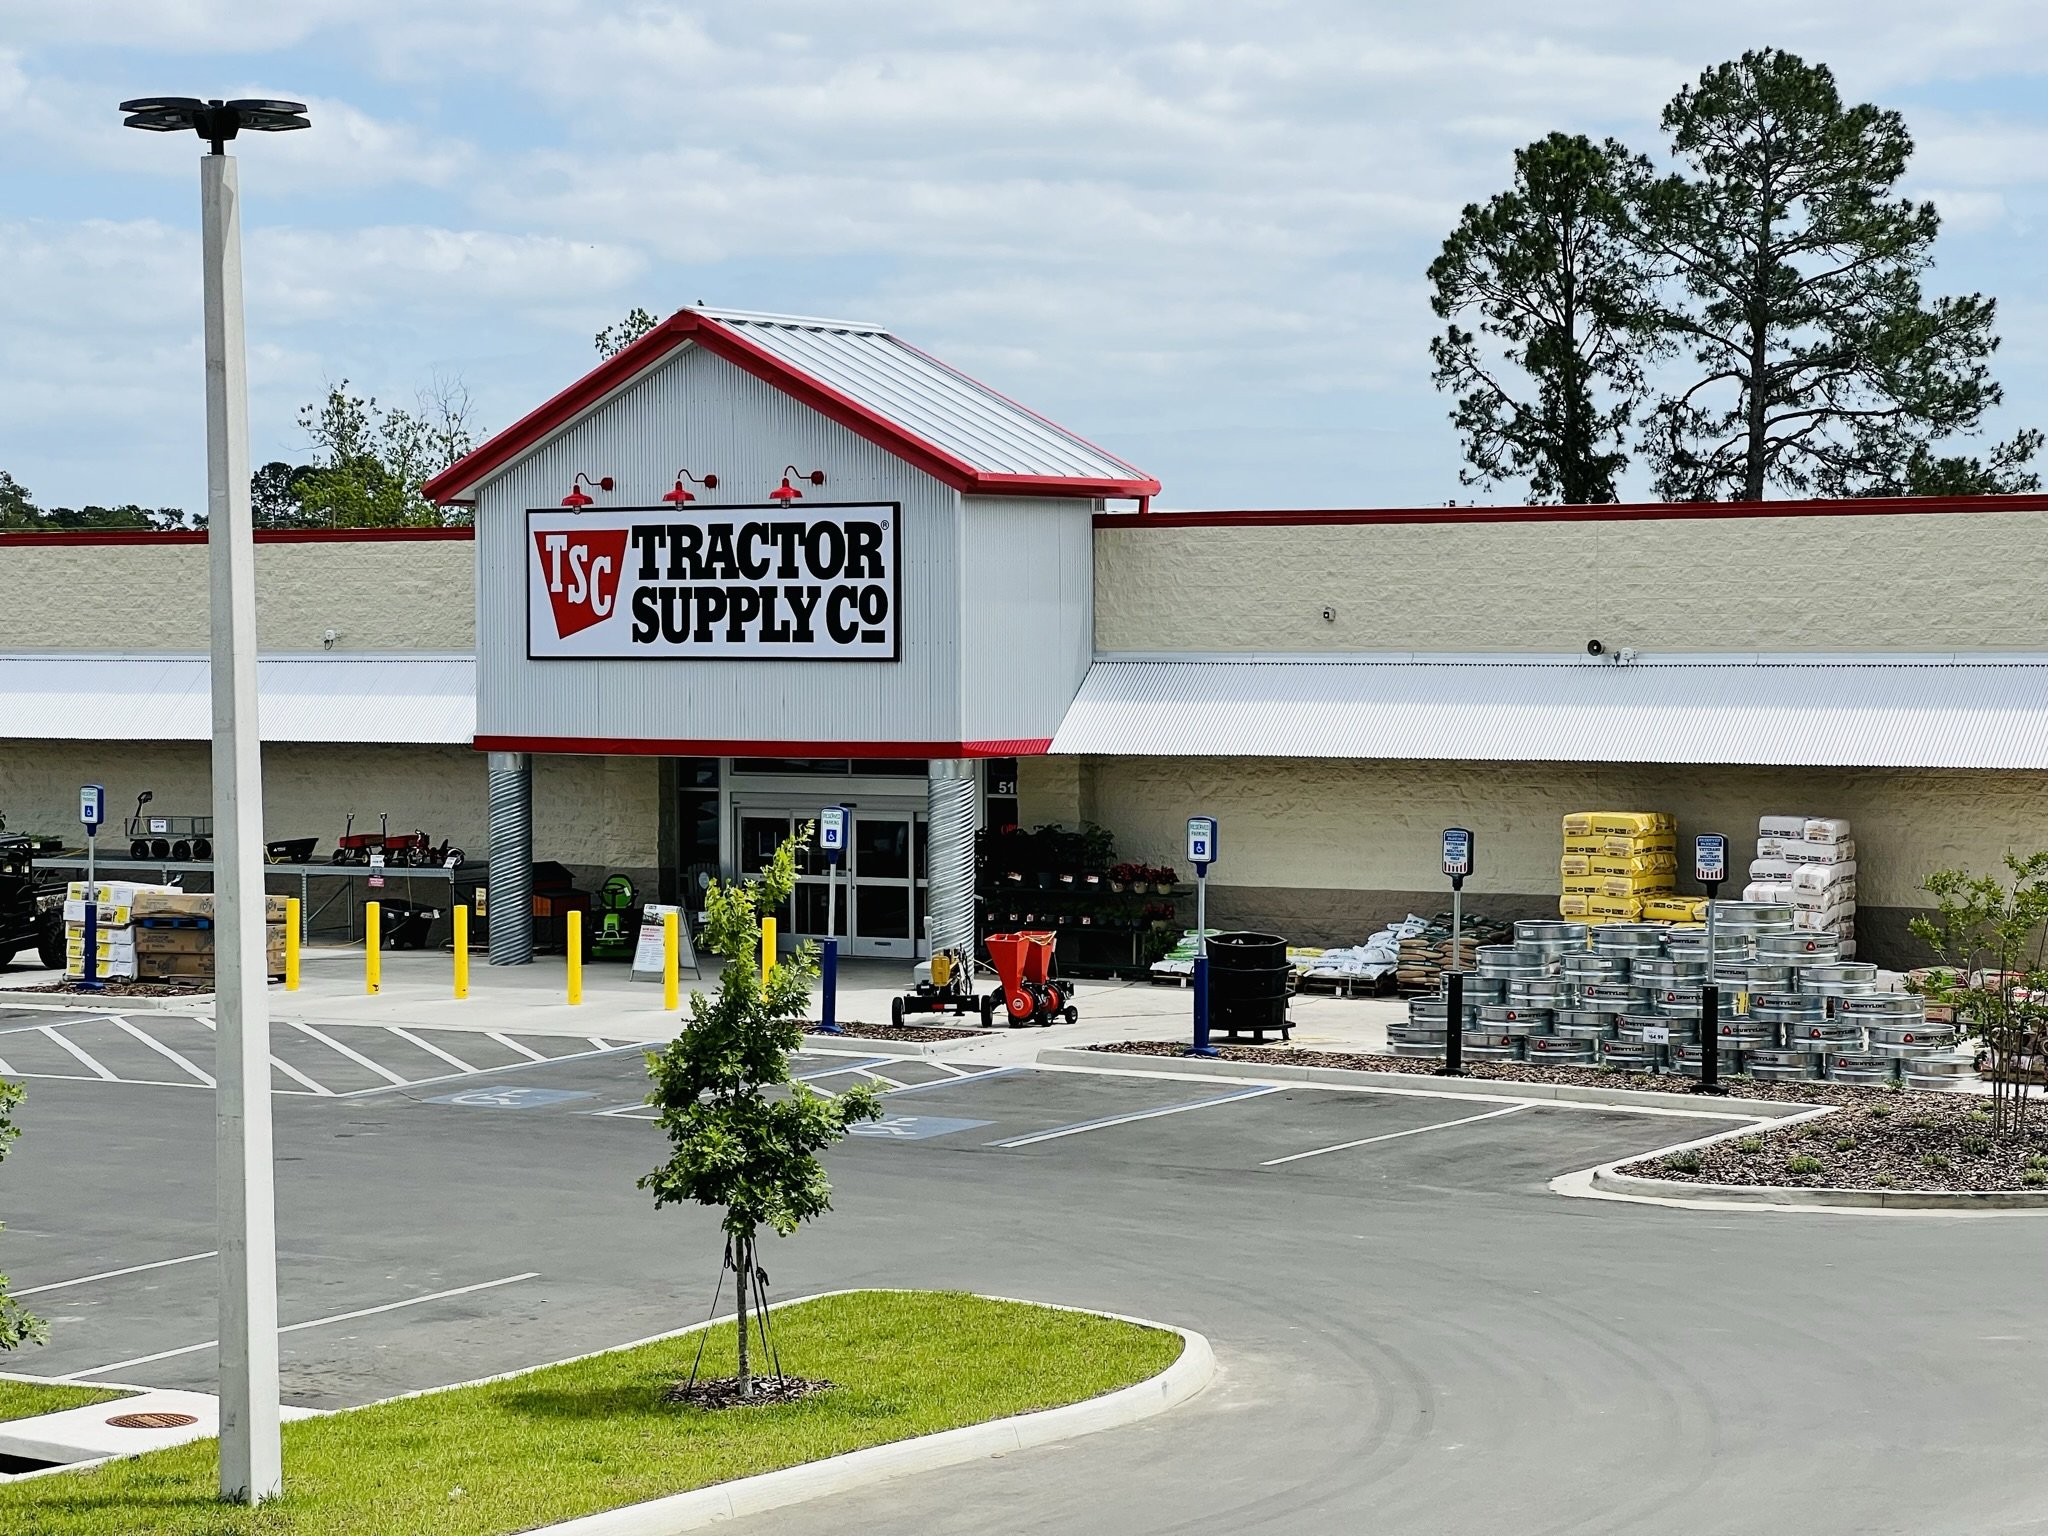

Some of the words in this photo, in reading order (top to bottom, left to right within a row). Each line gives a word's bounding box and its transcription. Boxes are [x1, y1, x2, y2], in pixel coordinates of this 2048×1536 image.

[545, 534, 612, 617] TSC
[632, 520, 886, 581] TRACTOR
[632, 585, 822, 644] SUPPLY
